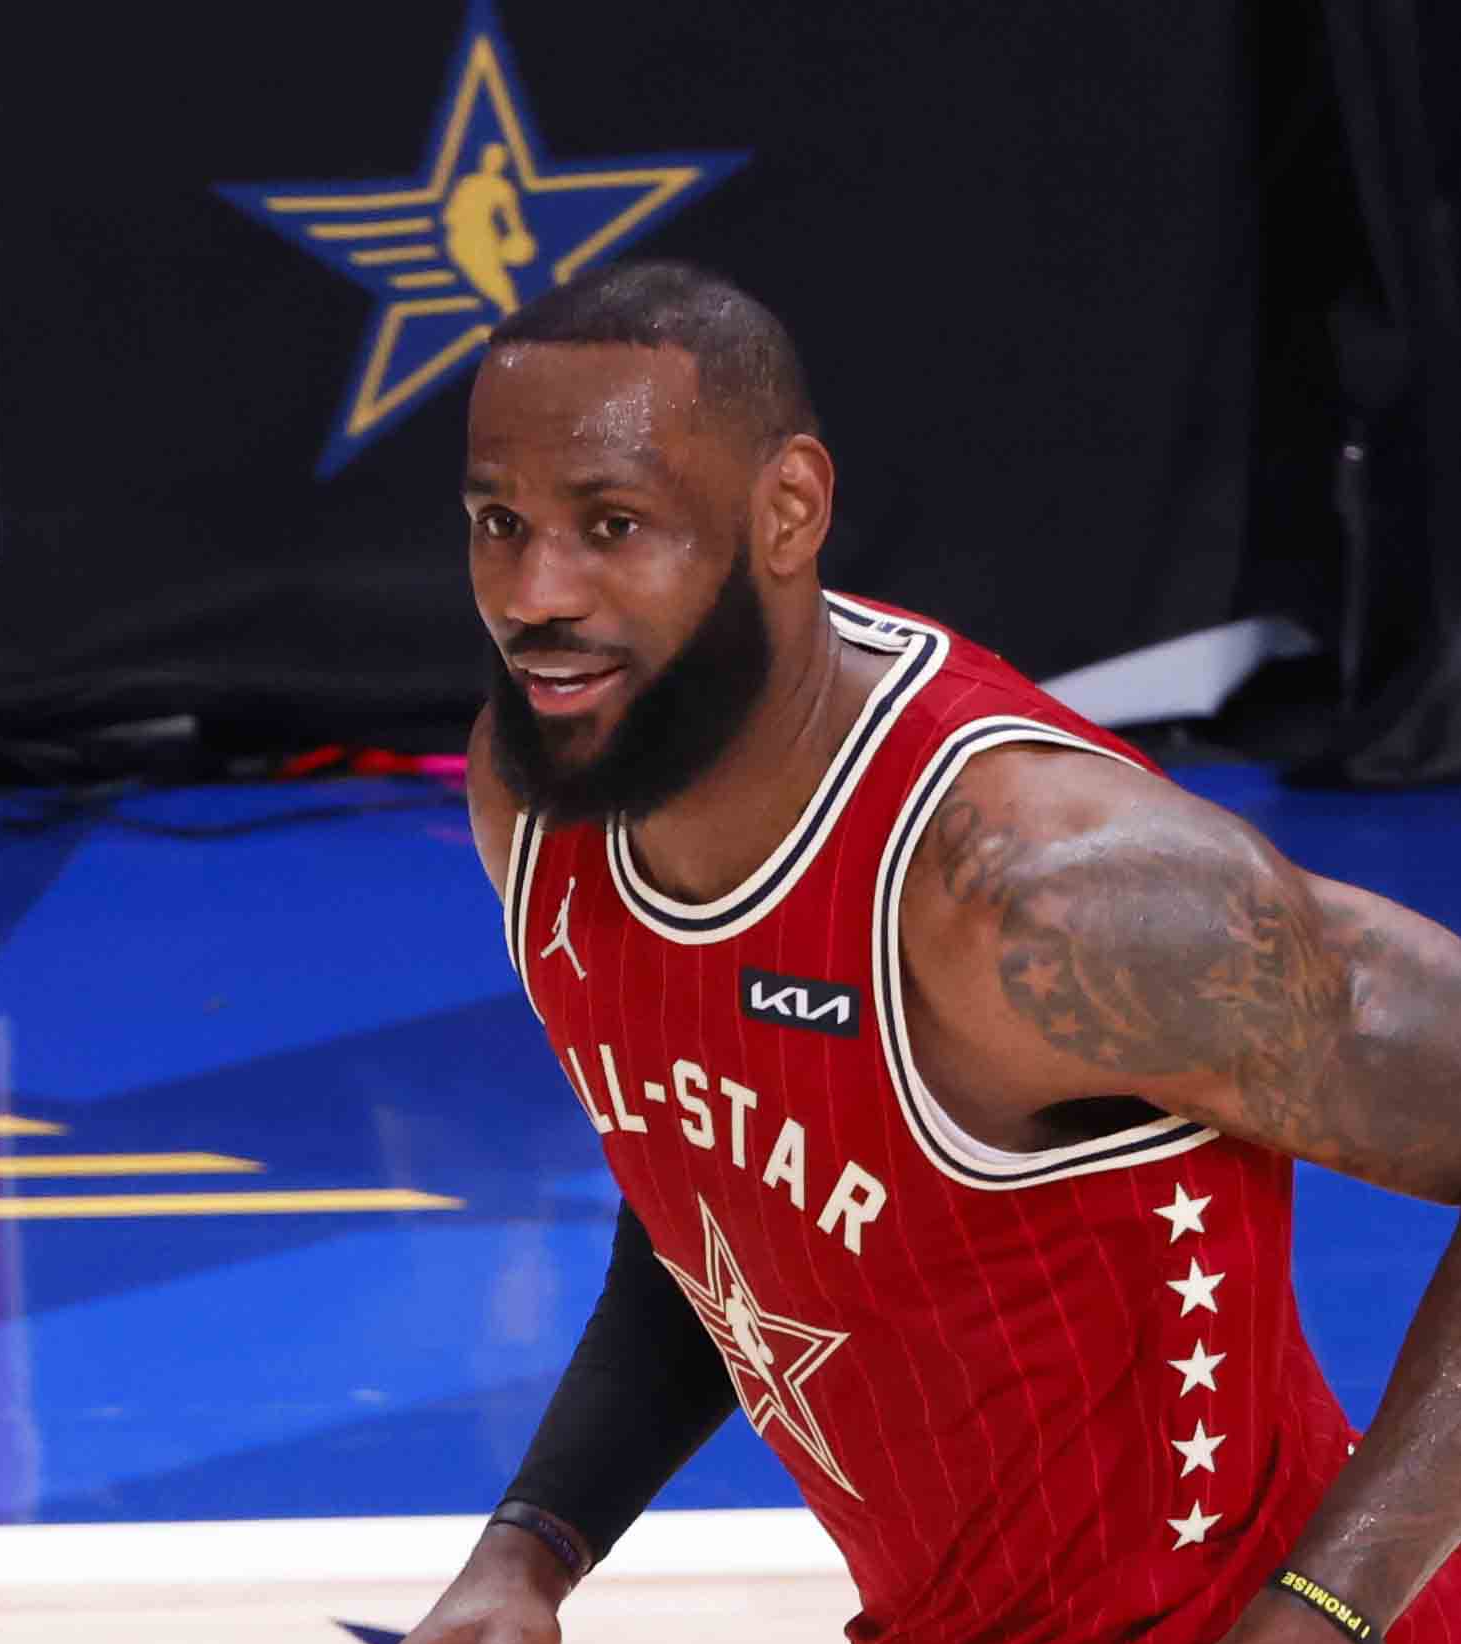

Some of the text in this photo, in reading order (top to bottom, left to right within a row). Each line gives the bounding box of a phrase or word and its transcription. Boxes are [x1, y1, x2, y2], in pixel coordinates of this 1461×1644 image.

[751, 980, 850, 1024] KIA
[561, 1044, 887, 1256] LL-STAR
[1281, 1571, 1371, 1639] I PROMISE
